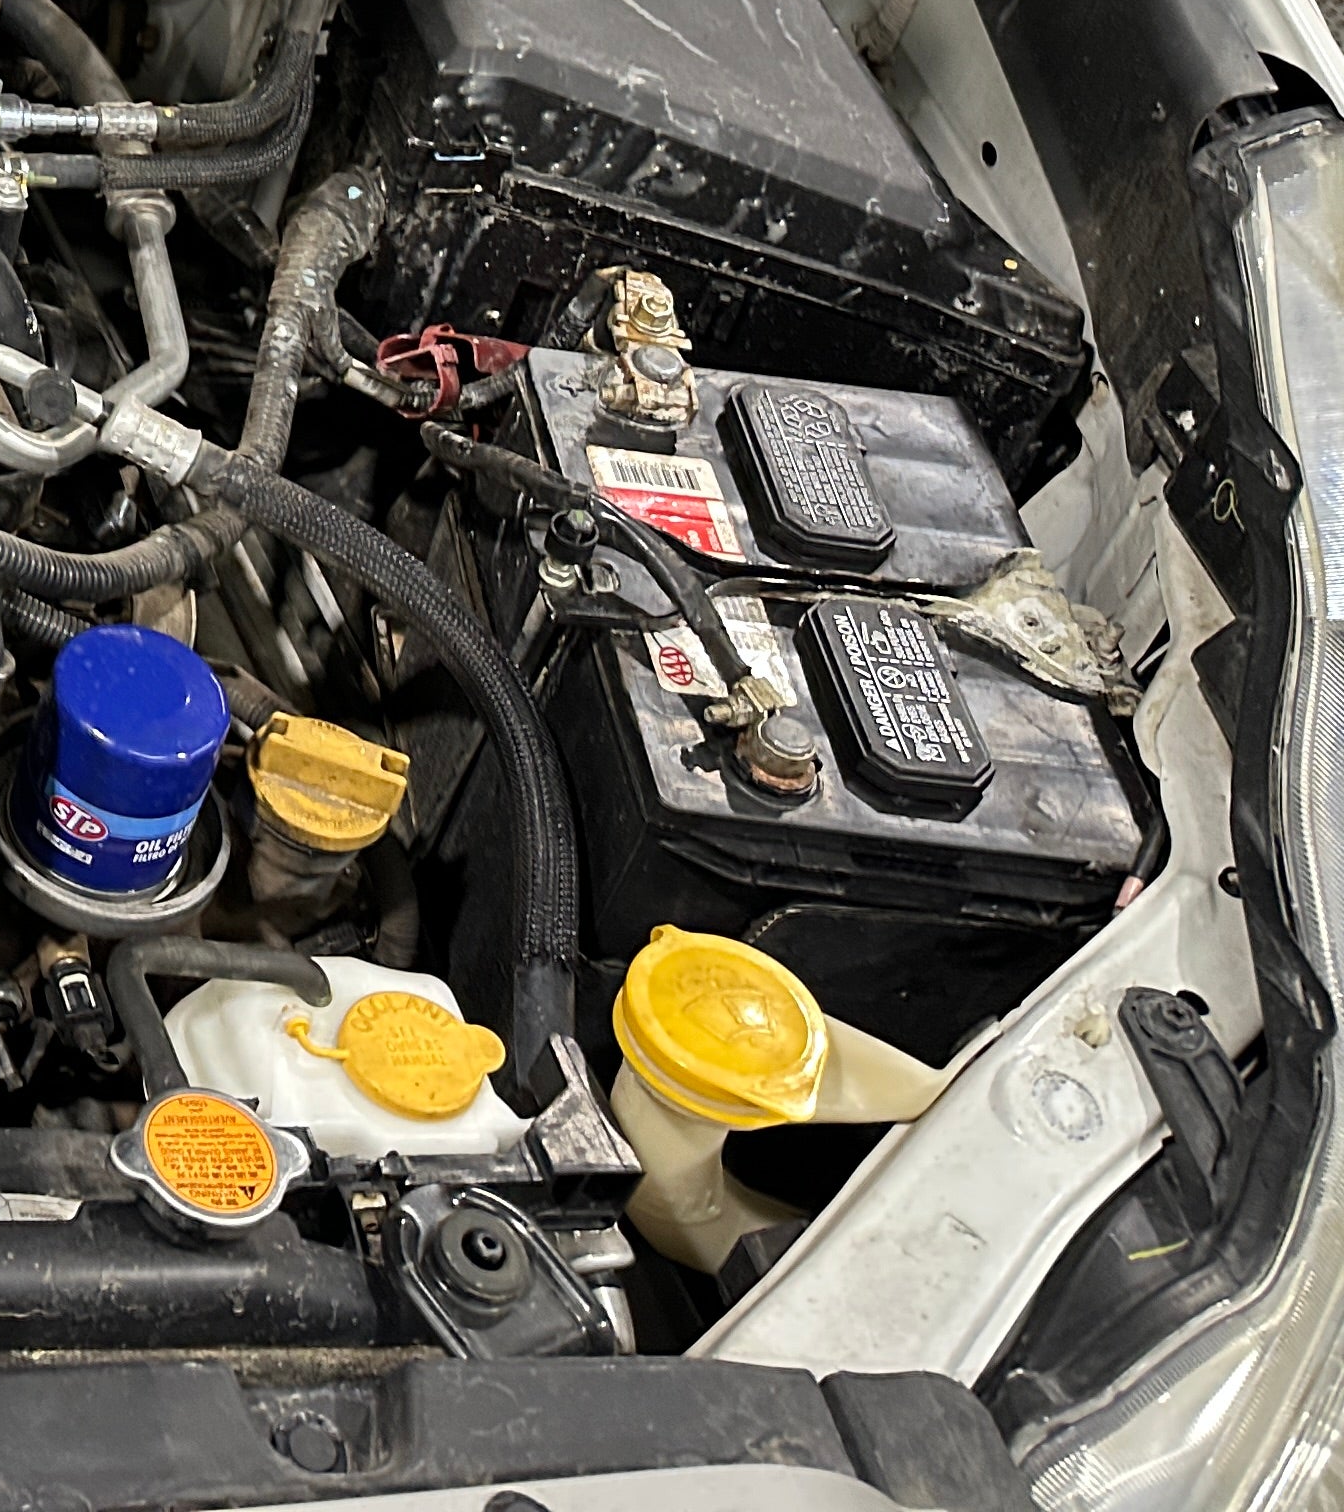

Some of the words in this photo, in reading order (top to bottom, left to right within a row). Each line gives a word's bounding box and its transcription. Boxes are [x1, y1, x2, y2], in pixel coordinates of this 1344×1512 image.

[833, 614, 867, 666] POISON
[859, 678, 896, 737] DANGER
[53, 802, 102, 834] STP
[133, 848, 167, 863] FILTRO
[135, 839, 161, 854] OIL
[350, 994, 458, 1033] COOLANT
